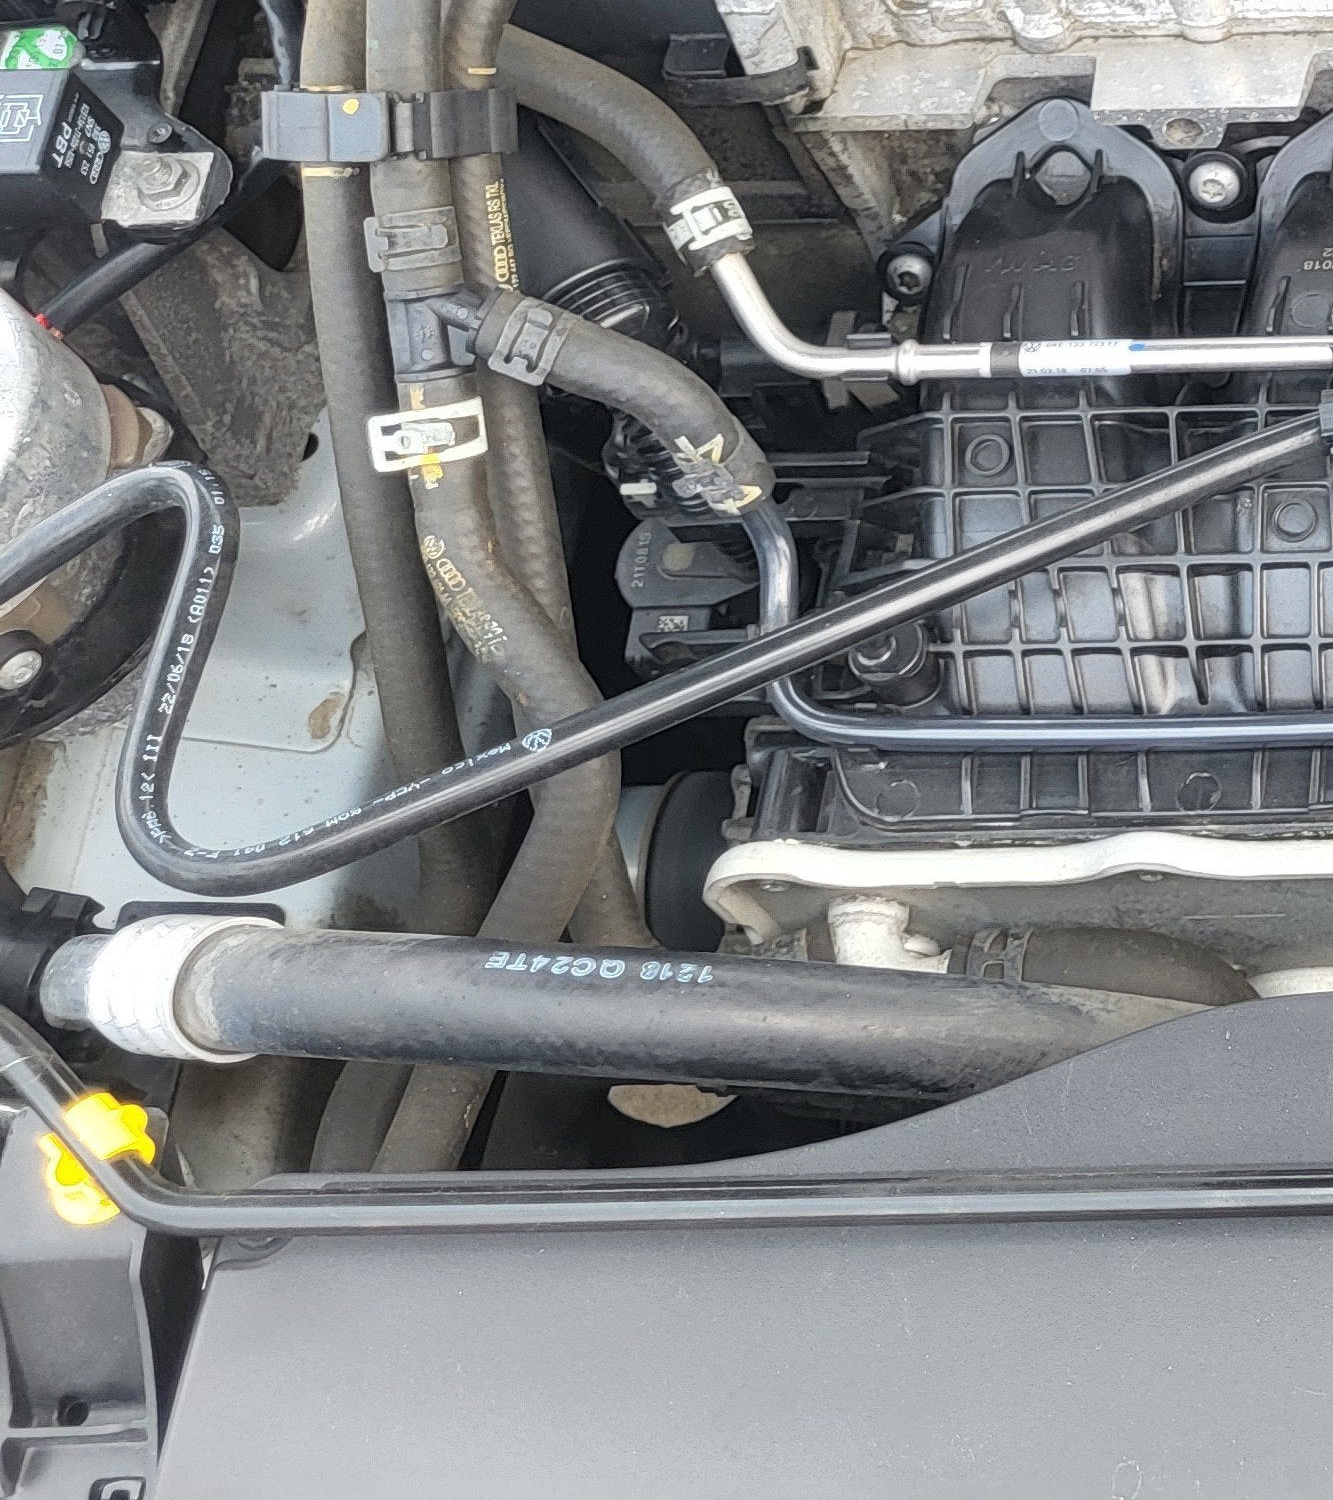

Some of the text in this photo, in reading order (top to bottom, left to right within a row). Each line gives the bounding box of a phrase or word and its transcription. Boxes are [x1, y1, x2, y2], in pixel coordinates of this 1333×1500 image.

[51, 120, 73, 169] PBT
[439, 739, 513, 778] Mexico
[483, 951, 626, 982] QC24TE
